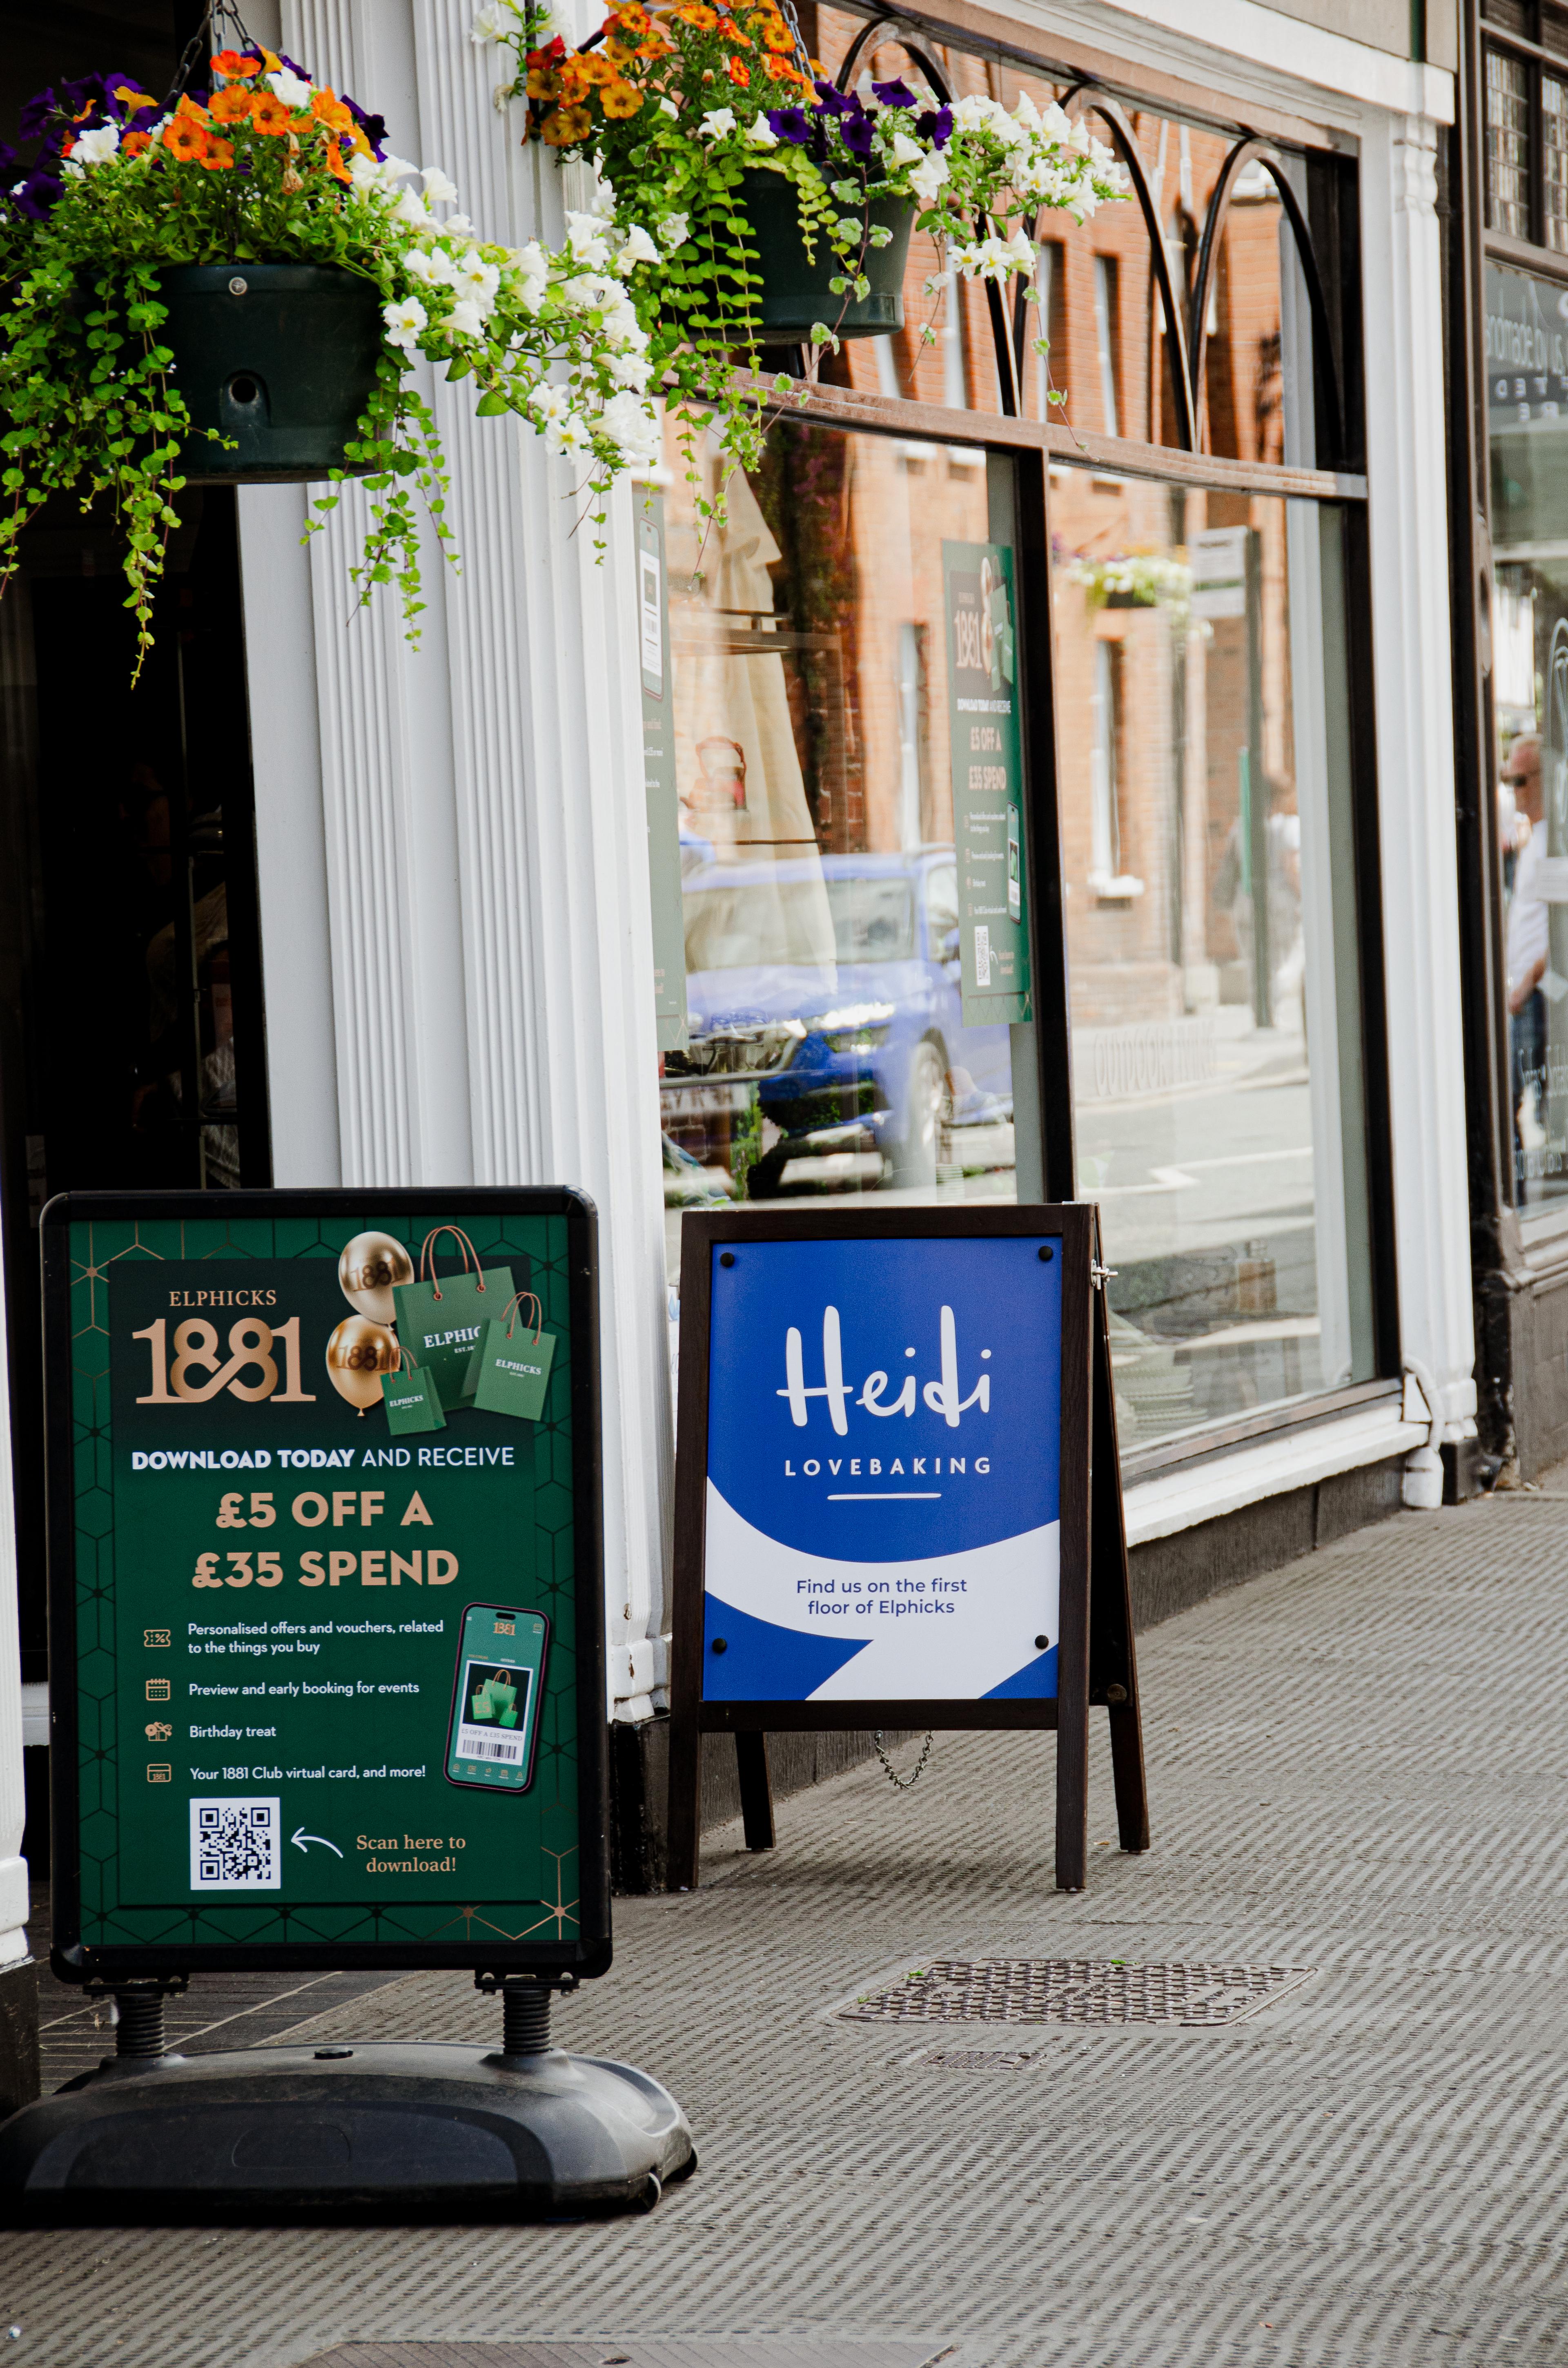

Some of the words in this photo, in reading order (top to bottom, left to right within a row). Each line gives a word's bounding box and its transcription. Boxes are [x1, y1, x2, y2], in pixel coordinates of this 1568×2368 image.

[981, 727, 995, 750] OFF
[996, 728, 1002, 750] A
[983, 766, 1006, 790] SPEND
[169, 1290, 276, 1306] ELPHICKS
[132, 1317, 316, 1403] 1881
[495, 1359, 541, 1375] ELPHICKS
[776, 1305, 991, 1436] Heidi
[390, 1395, 424, 1407] ELPHICKS
[132, 1450, 271, 1469] DOWNLOAD
[277, 1449, 355, 1467] TODAY
[362, 1449, 410, 1466] AND
[419, 1447, 514, 1466] RECEIVE
[786, 1457, 989, 1476] LOVEBAKING
[216, 1493, 276, 1528] £5
[292, 1491, 384, 1527] OFF
[401, 1491, 433, 1525] A
[192, 1552, 283, 1588] £35
[298, 1550, 459, 1586] SPEND
[797, 1579, 834, 1593] Find
[842, 1583, 861, 1592] us
[868, 1583, 889, 1592] on
[896, 1579, 925, 1592] the
[931, 1578, 967, 1592] first
[808, 1601, 849, 1614] floor
[856, 1600, 873, 1614] of
[880, 1599, 954, 1617] Elphicks
[189, 1622, 267, 1634] Personalised
[271, 1621, 306, 1634] offers
[310, 1621, 332, 1633] and
[336, 1621, 395, 1634] vouchers,
[399, 1620, 443, 1632] related
[188, 1644, 201, 1653] to
[205, 1641, 225, 1653] the
[229, 1641, 267, 1656] things
[271, 1644, 293, 1655] you
[297, 1640, 320, 1654] buy
[189, 1684, 238, 1695] Preview
[242, 1682, 265, 1695] and
[269, 1682, 299, 1697] early
[303, 1681, 353, 1697] booking
[357, 1681, 375, 1693] for
[378, 1683, 419, 1693] events
[190, 1725, 242, 1740] Birthday
[246, 1727, 276, 1737] treat
[190, 1768, 219, 1779] Your
[223, 1767, 248, 1779] 1881
[252, 1766, 283, 1779] Club
[286, 1766, 325, 1778] virtual
[329, 1766, 359, 1779] card,
[363, 1765, 386, 1777] and
[390, 1765, 425, 1777] more!
[357, 1835, 398, 1849] Scan
[404, 1835, 443, 1849] here
[449, 1837, 466, 1848] to
[367, 1857, 455, 1872] download!
